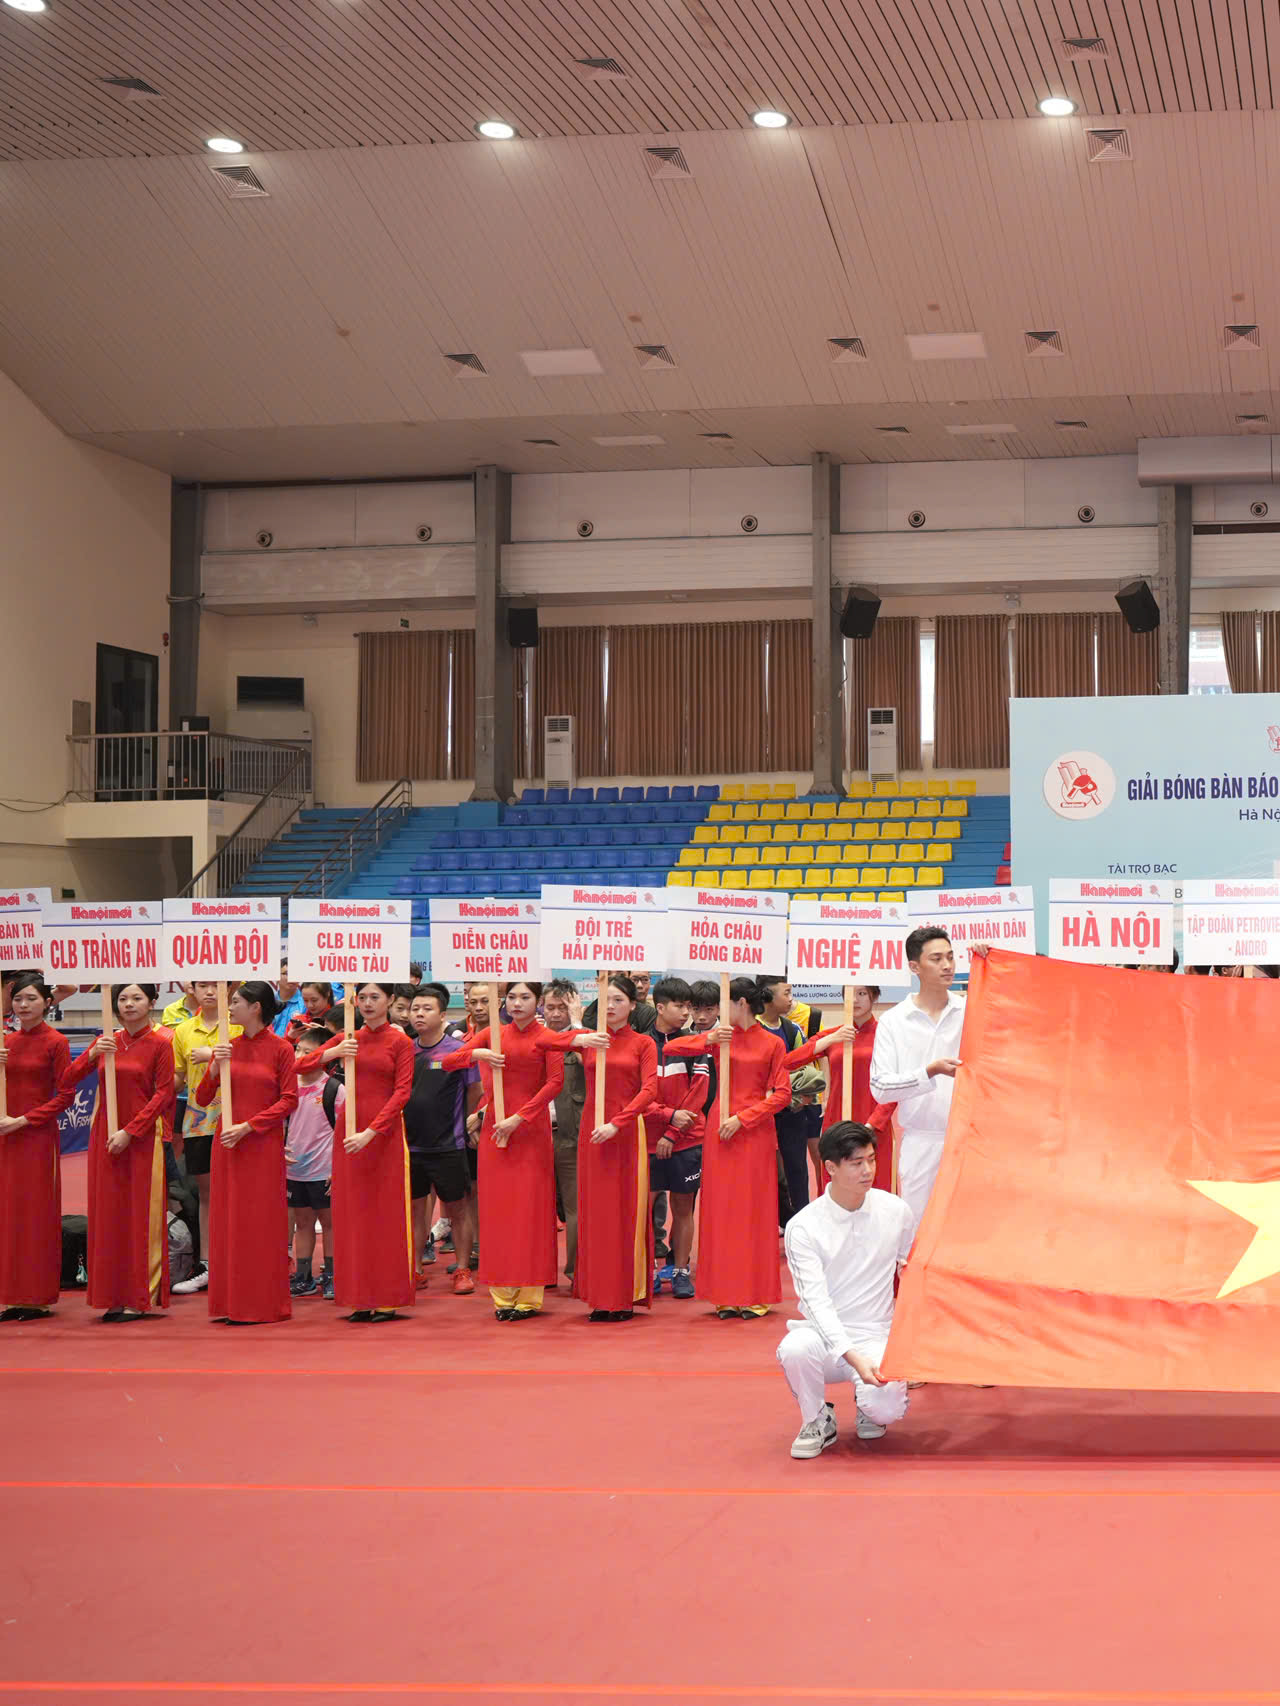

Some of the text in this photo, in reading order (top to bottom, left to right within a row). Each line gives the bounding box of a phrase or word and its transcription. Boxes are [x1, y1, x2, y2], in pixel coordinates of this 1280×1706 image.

[1127, 772, 1158, 800] GIẢI
[1163, 774, 1206, 799] BÓNG
[1211, 773, 1243, 798] BÀN
[1248, 772, 1279, 798] BÁO
[1239, 807, 1258, 820] Hà
[1108, 862, 1177, 876] TÀI TRỢ BẠC
[575, 916, 633, 939] ĐỘI TRẺ
[690, 916, 763, 941] HỎA CHÂU
[951, 924, 966, 941] AN
[969, 919, 1000, 940] NHÂN
[1003, 918, 1026, 938] DÂN
[1062, 910, 1161, 955] HÀ NỘI
[1187, 914, 1205, 937] TẬP
[16, 941, 30, 959] HÀ
[172, 928, 268, 971] QUÂN ĐỘI
[317, 932, 382, 949] CLB LINH
[452, 927, 528, 950] DIỄN CHÂU
[562, 938, 645, 962] HẢI PHÒNG
[1235, 940, 1268, 956] ANDRO
[50, 939, 78, 969] CLB
[82, 932, 131, 968] TRÀNG
[136, 938, 157, 967] AN
[689, 940, 762, 965] BÓNG BÀN
[797, 933, 903, 976] NGHỆ AN
[318, 954, 361, 973] VŨNG
[365, 953, 389, 973] TÀU
[465, 954, 504, 977] NGHỆ
[507, 956, 528, 973] AN
[685, 1168, 702, 1182] XIO
